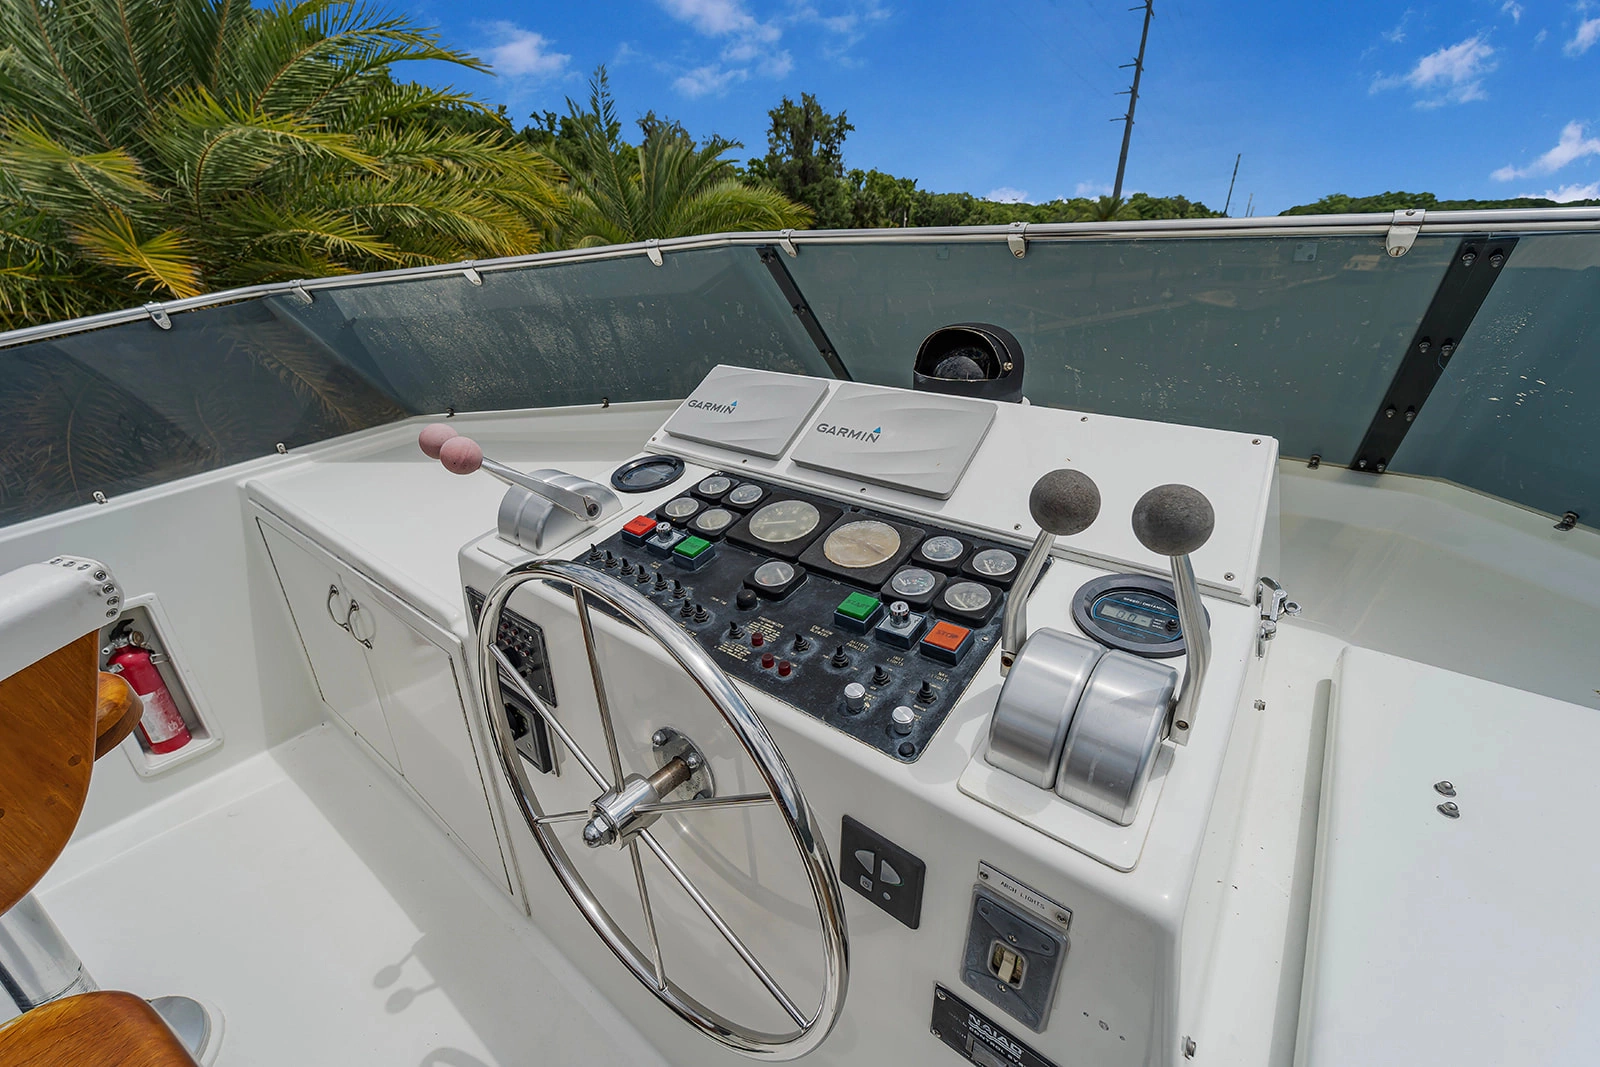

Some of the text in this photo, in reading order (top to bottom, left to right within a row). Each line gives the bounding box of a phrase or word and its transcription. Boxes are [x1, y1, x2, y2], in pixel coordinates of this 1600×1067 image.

[687, 399, 736, 415] GARMIN
[816, 423, 881, 444] GARMIN
[847, 599, 870, 609] START
[936, 628, 959, 640] STOP
[1000, 881, 1046, 910] ARCH LIGHTS
[968, 1013, 1023, 1055] NAIAD
[968, 1027, 1006, 1055] CONTROL
